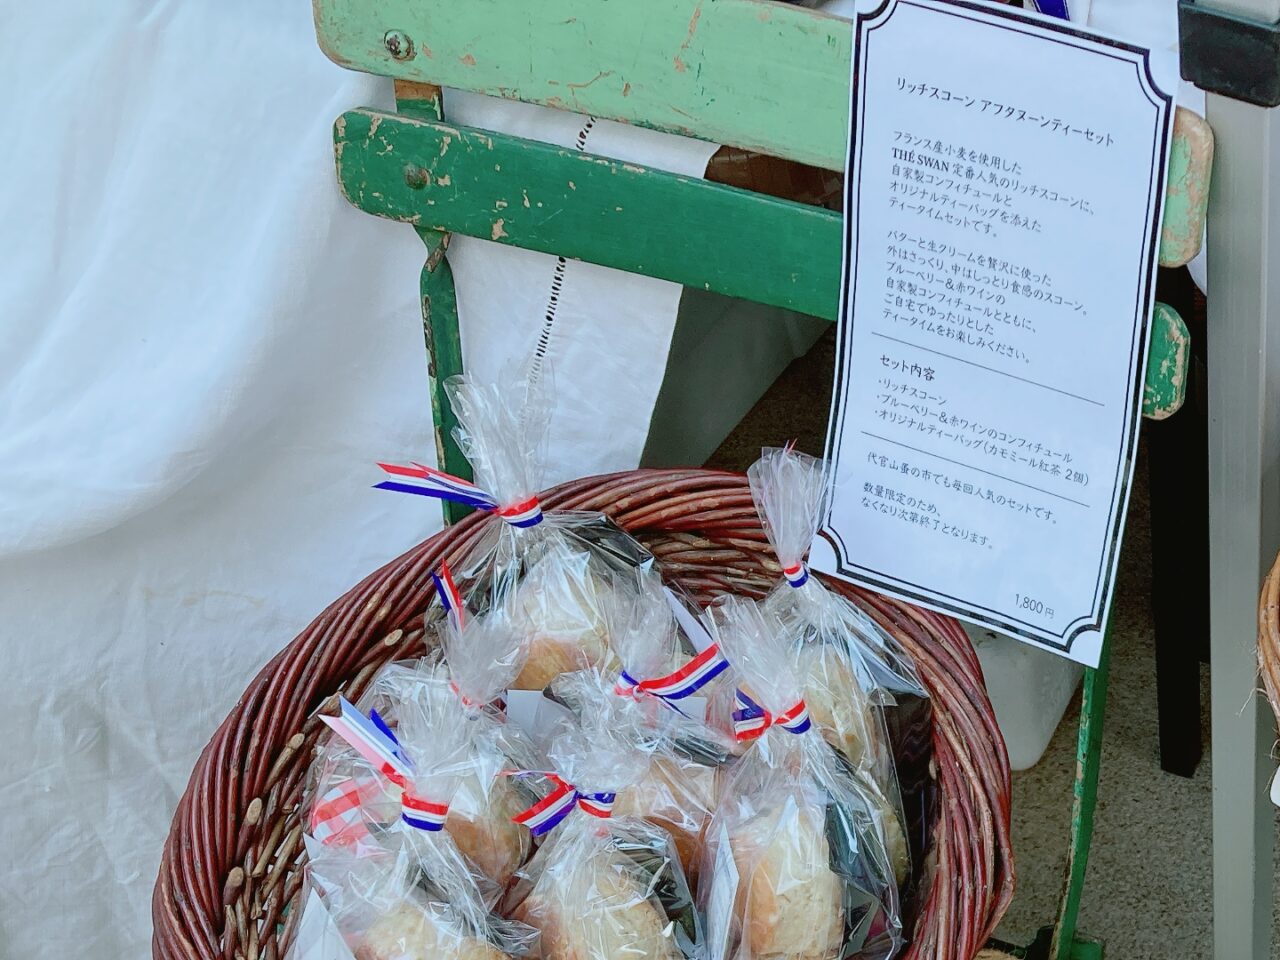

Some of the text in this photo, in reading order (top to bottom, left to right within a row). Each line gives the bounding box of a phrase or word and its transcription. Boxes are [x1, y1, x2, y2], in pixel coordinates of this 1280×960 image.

[897, 77, 1114, 147] リッチスコーン アフタヌーンティーセット
[893, 130, 1022, 175] フランス産小麦を使用した
[889, 180, 1041, 233] オリジナルティーバッグを添えた
[892, 146, 1094, 215] THÉ SWAN 定番人気のリッチスコーンに、
[892, 163, 1013, 207] 自家製コンフィチュールと
[889, 197, 997, 237] ティータイムセットです。
[886, 261, 1005, 305] ブルーベリー&赤ワインの
[887, 230, 1051, 287] バターと生クリームを贅沢に使った
[887, 245, 1087, 315] 外はさっくり、中はしっとり食感のスコーン。
[884, 293, 994, 335] ご自宅でゆったりとした
[886, 276, 1036, 333] 自家製コンフィチュールとともに、
[883, 309, 1030, 363] ティータイムをお楽しみください。
[880, 355, 935, 381] セット内容
[863, 482, 941, 517] 数量限定のため、
[867, 451, 1057, 524] 代官山蚤の市でも毎回人気のセットです。
[862, 497, 993, 549] なくなり次第終了となります。
